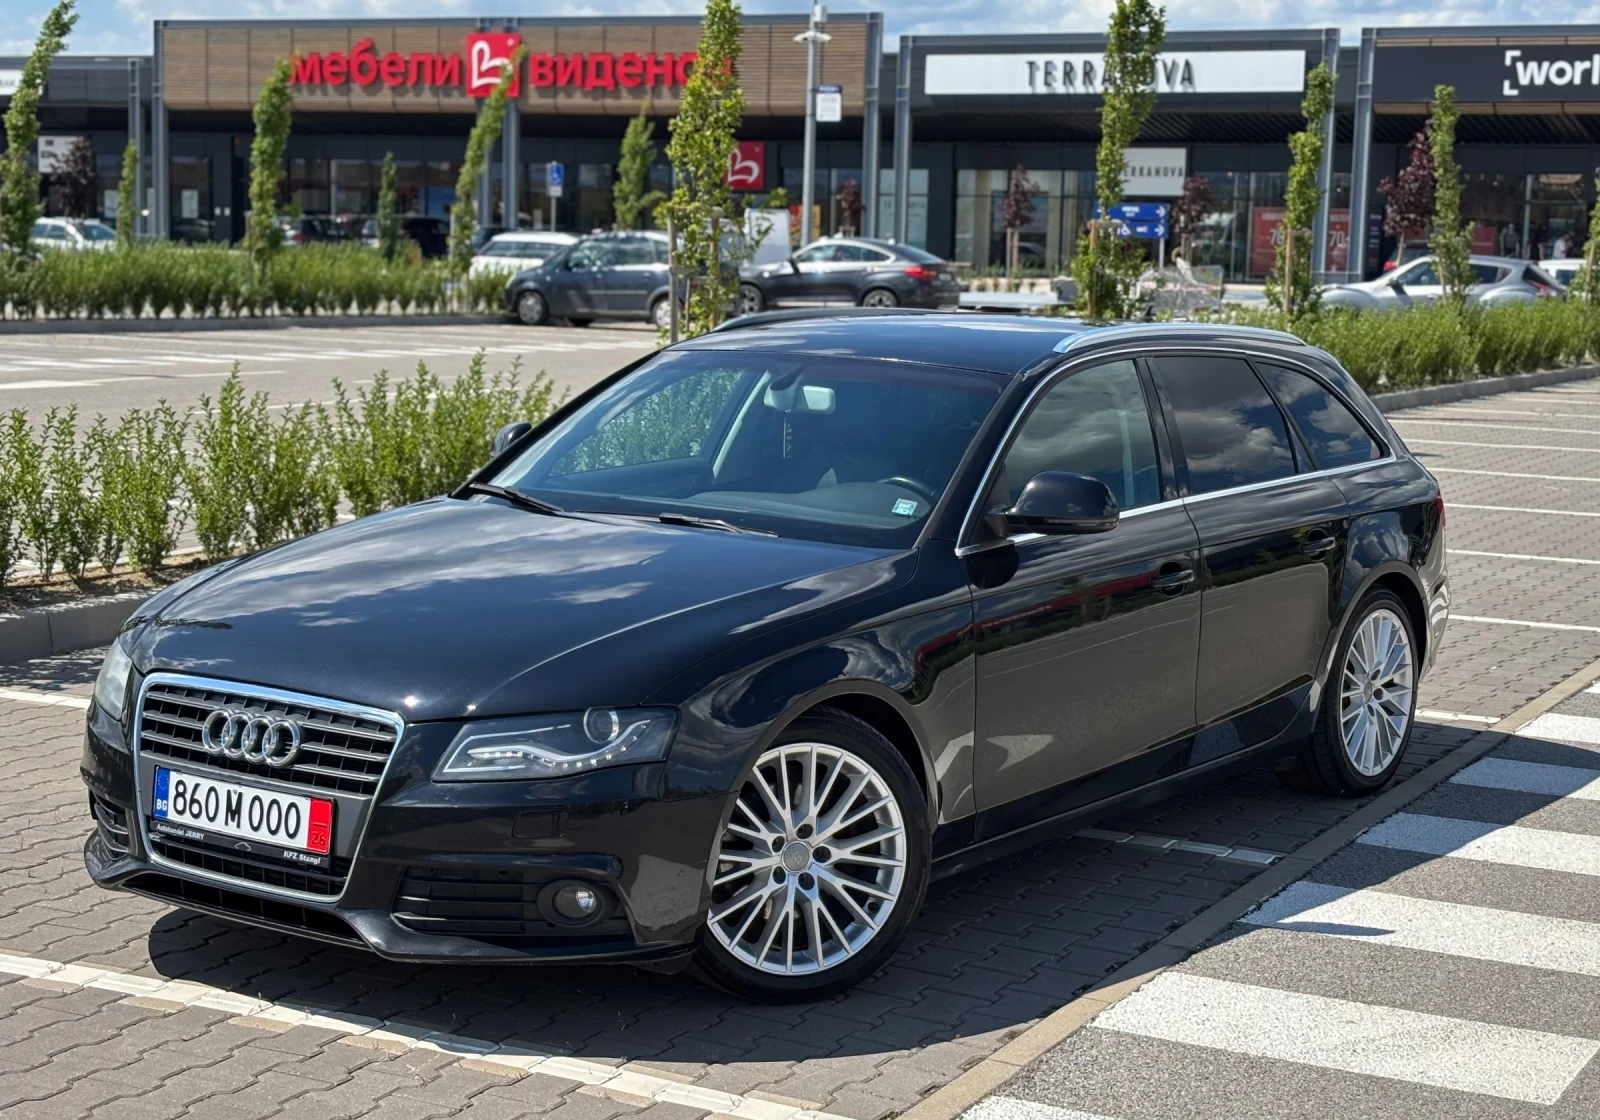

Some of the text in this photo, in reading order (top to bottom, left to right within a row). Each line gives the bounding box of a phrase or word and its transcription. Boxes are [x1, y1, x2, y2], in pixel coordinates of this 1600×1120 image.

[290, 38, 733, 91] мебели видено
[1122, 166, 1184, 177] ERRANOVA
[156, 799, 168, 811] BG
[173, 779, 301, 839] 860 M 000
[156, 823, 205, 840] Autohandel JERRY
[311, 831, 326, 846] 26
[283, 850, 321, 865] KFZ Stangl
